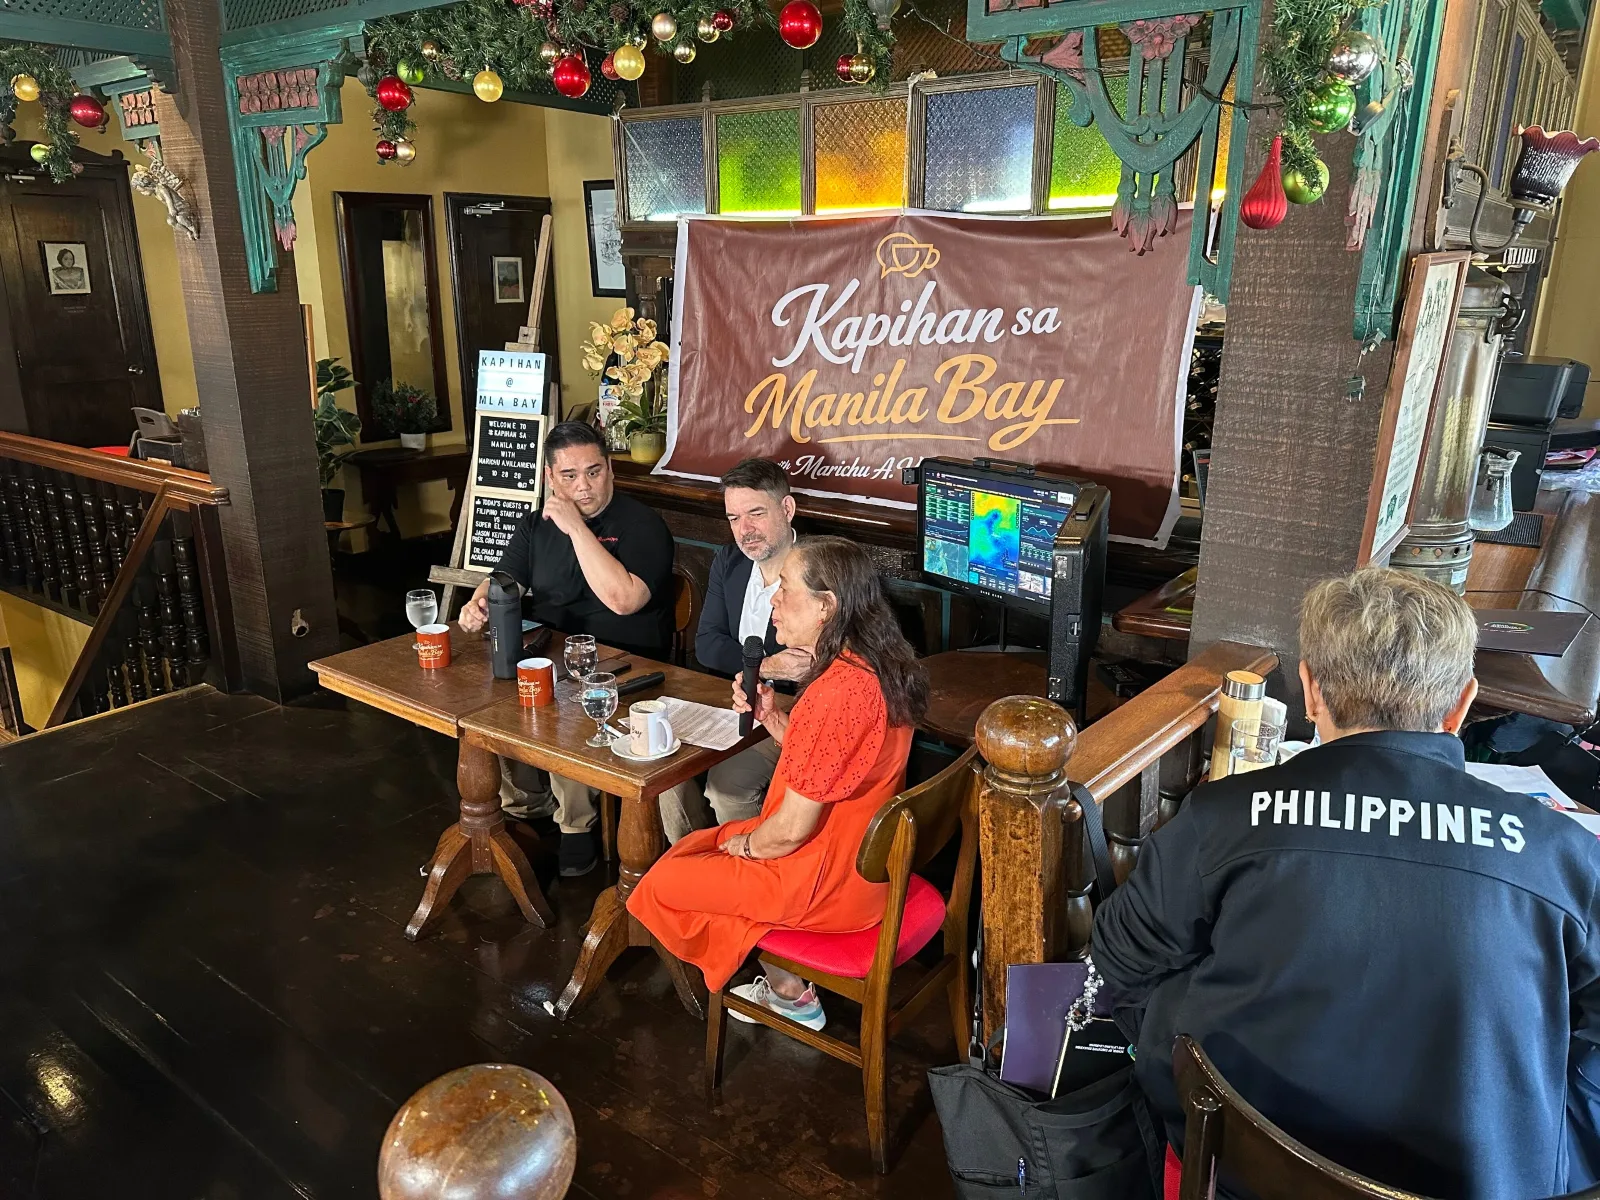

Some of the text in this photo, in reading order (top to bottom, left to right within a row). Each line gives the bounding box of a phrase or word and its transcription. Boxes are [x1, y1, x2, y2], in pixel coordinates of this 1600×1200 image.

[771, 279, 1061, 374] Kapihan sa
[481, 356, 541, 369] KAPIHAN
[505, 377, 514, 388] @
[479, 395, 537, 409] MLA BAY
[743, 353, 1081, 452] Manila Bay
[489, 421, 527, 430] WELCOME TO
[490, 440, 527, 451] MANILA BAY
[478, 457, 501, 466] MARICHU
[790, 454, 870, 480] Marichu
[869, 456, 896, 480] A.
[475, 521, 491, 529] SUPER
[1251, 789, 1526, 853] PHILIPPINES
